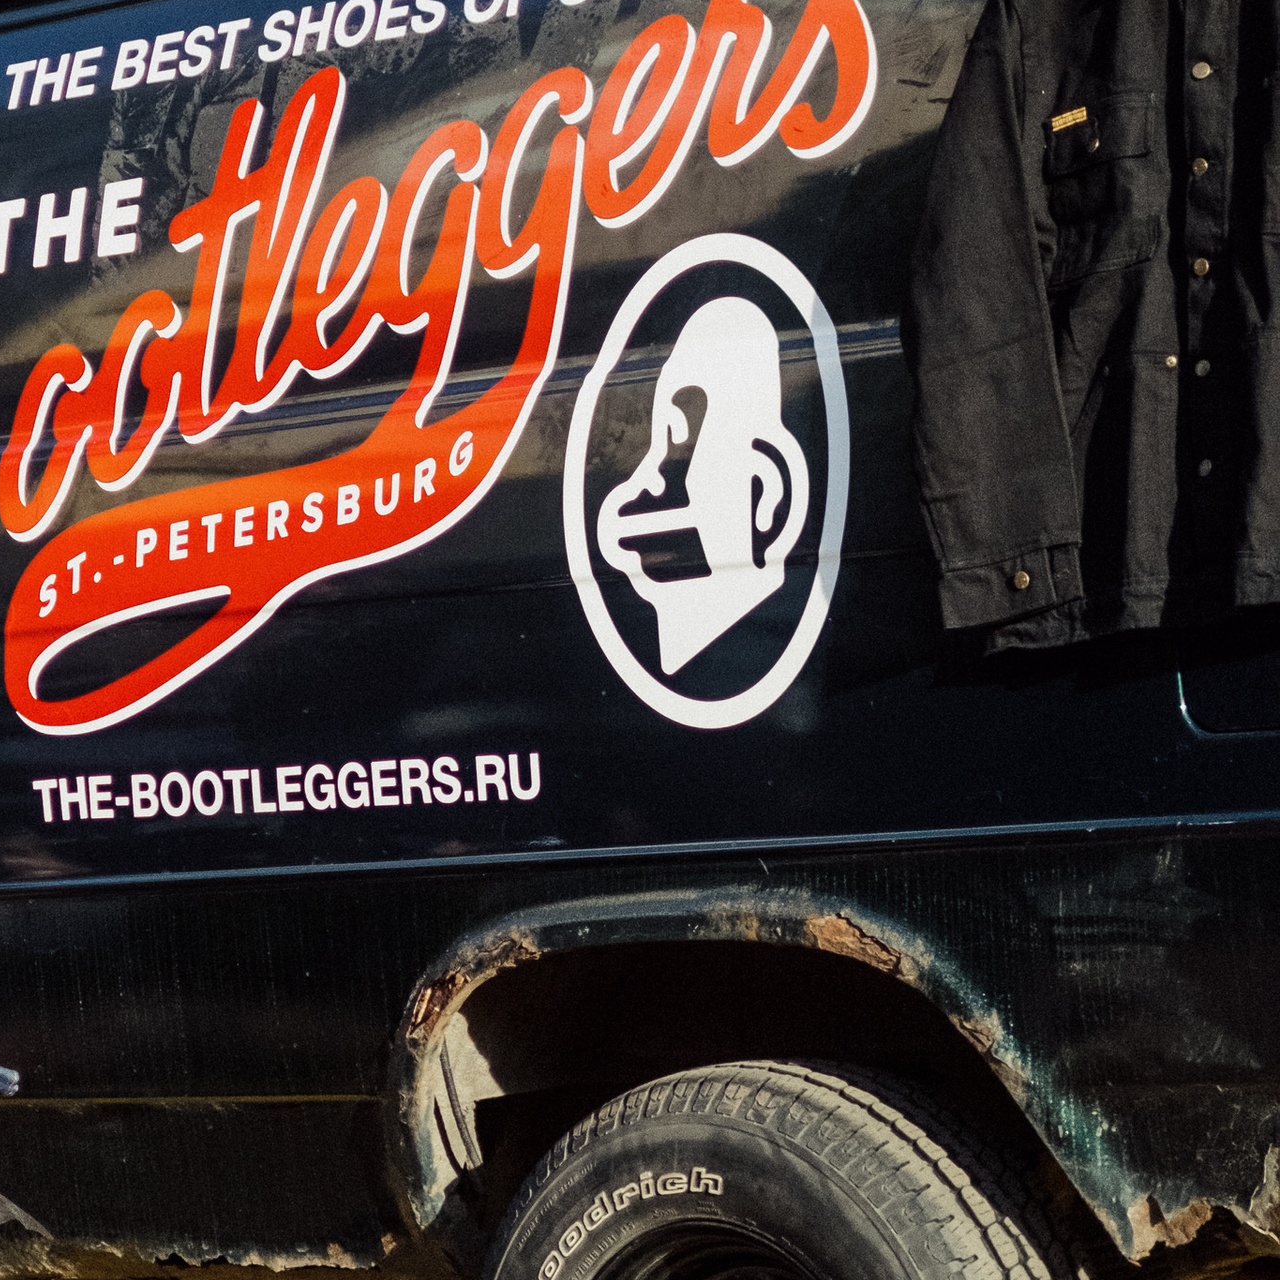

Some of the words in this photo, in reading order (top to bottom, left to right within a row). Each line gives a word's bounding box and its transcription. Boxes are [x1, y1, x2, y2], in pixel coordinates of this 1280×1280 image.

[5, 45, 104, 110] THE
[111, 17, 251, 91] BEST
[37, 429, 477, 619] ST.-PETERSBURG
[31, 752, 543, 824] THE-BOOTLEGGERS.RU
